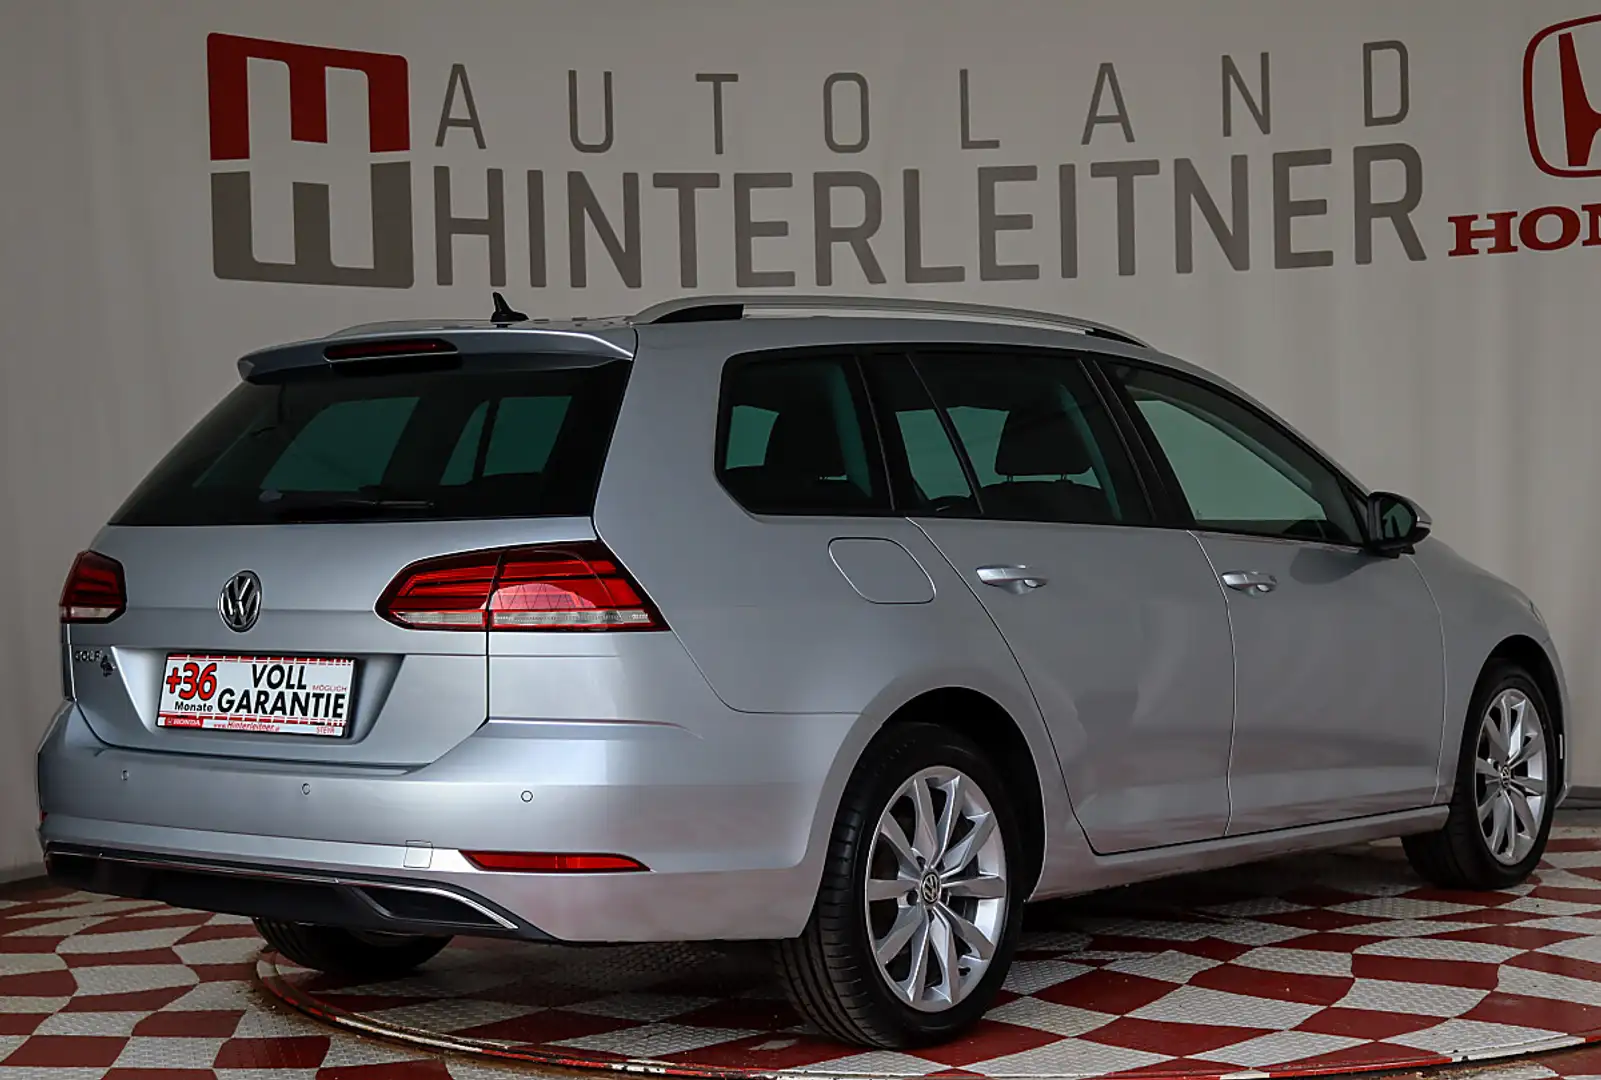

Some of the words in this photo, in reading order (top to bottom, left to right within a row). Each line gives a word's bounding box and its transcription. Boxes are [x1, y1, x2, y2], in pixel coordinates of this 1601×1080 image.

[434, 40, 1410, 155] AUTOLAND
[433, 143, 1428, 288] HINTERLEITNER
[1447, 203, 1601, 257] HO
[166, 662, 218, 701] +36
[252, 664, 307, 690] VOLL
[174, 700, 213, 713] Monate
[217, 688, 346, 718] GARANTIE
